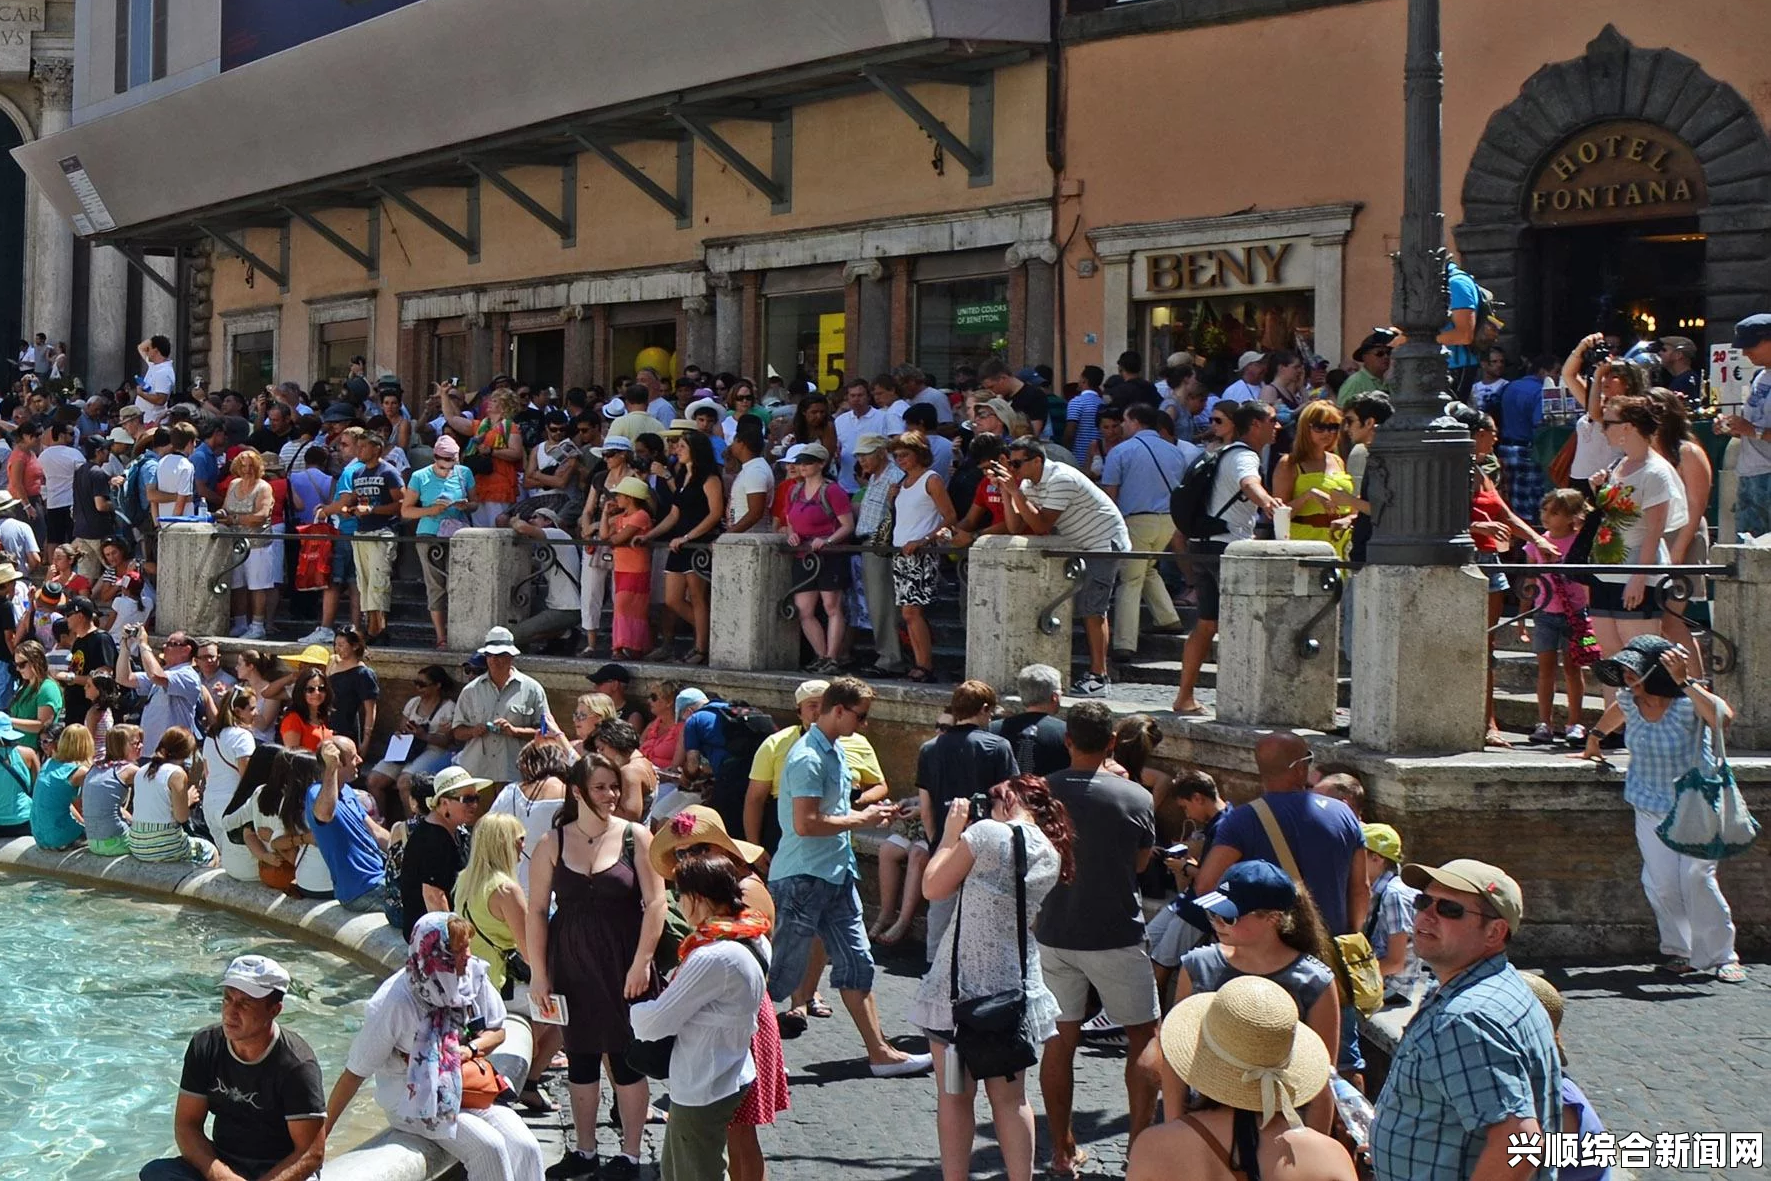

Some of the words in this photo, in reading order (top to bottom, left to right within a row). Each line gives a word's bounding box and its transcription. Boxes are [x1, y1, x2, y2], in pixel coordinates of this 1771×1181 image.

[1552, 135, 1669, 181] HOTEL
[1532, 179, 1692, 212] FONTANA
[1146, 243, 1293, 292] BENY
[957, 306, 980, 315] UNITED
[981, 304, 1007, 313] COLORS
[1713, 351, 1726, 363] 20
[1720, 366, 1727, 383] 1
[1733, 366, 1742, 380] €
